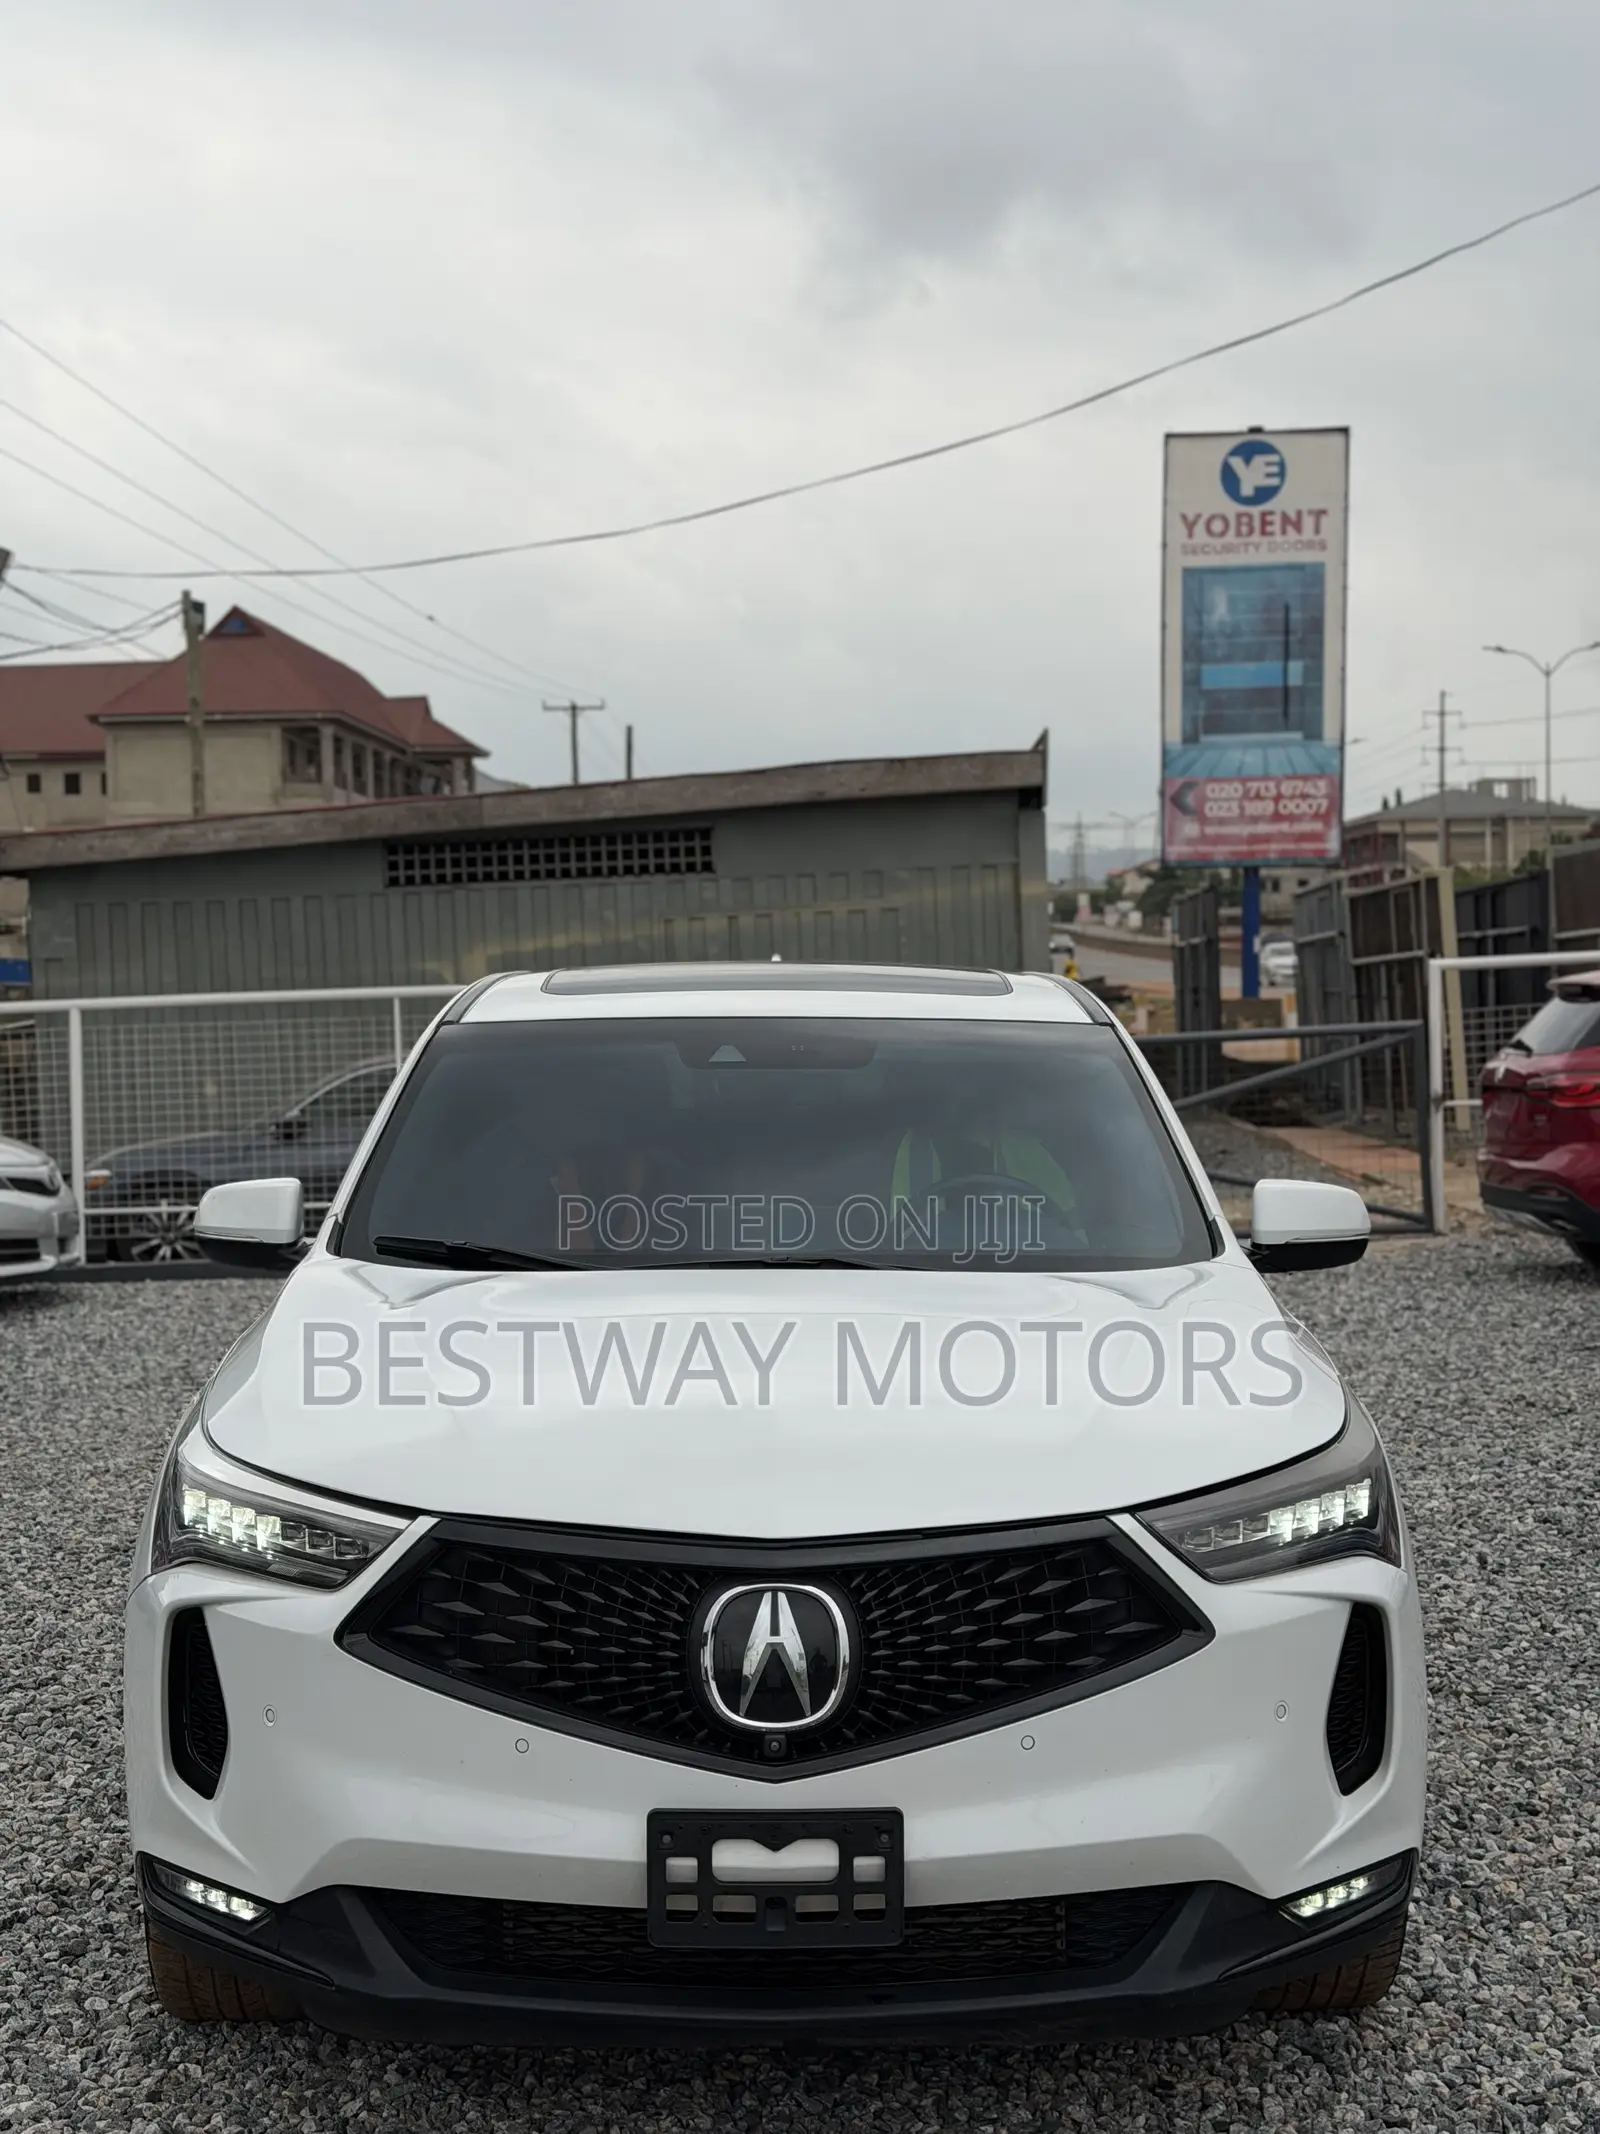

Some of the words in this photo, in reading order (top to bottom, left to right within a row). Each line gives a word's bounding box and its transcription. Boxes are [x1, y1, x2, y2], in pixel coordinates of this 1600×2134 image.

[1180, 508, 1329, 539] YOBENT
[1181, 541, 1262, 556] SECURITY
[1267, 538, 1328, 553] DOORS
[1278, 798, 1328, 815] 0007
